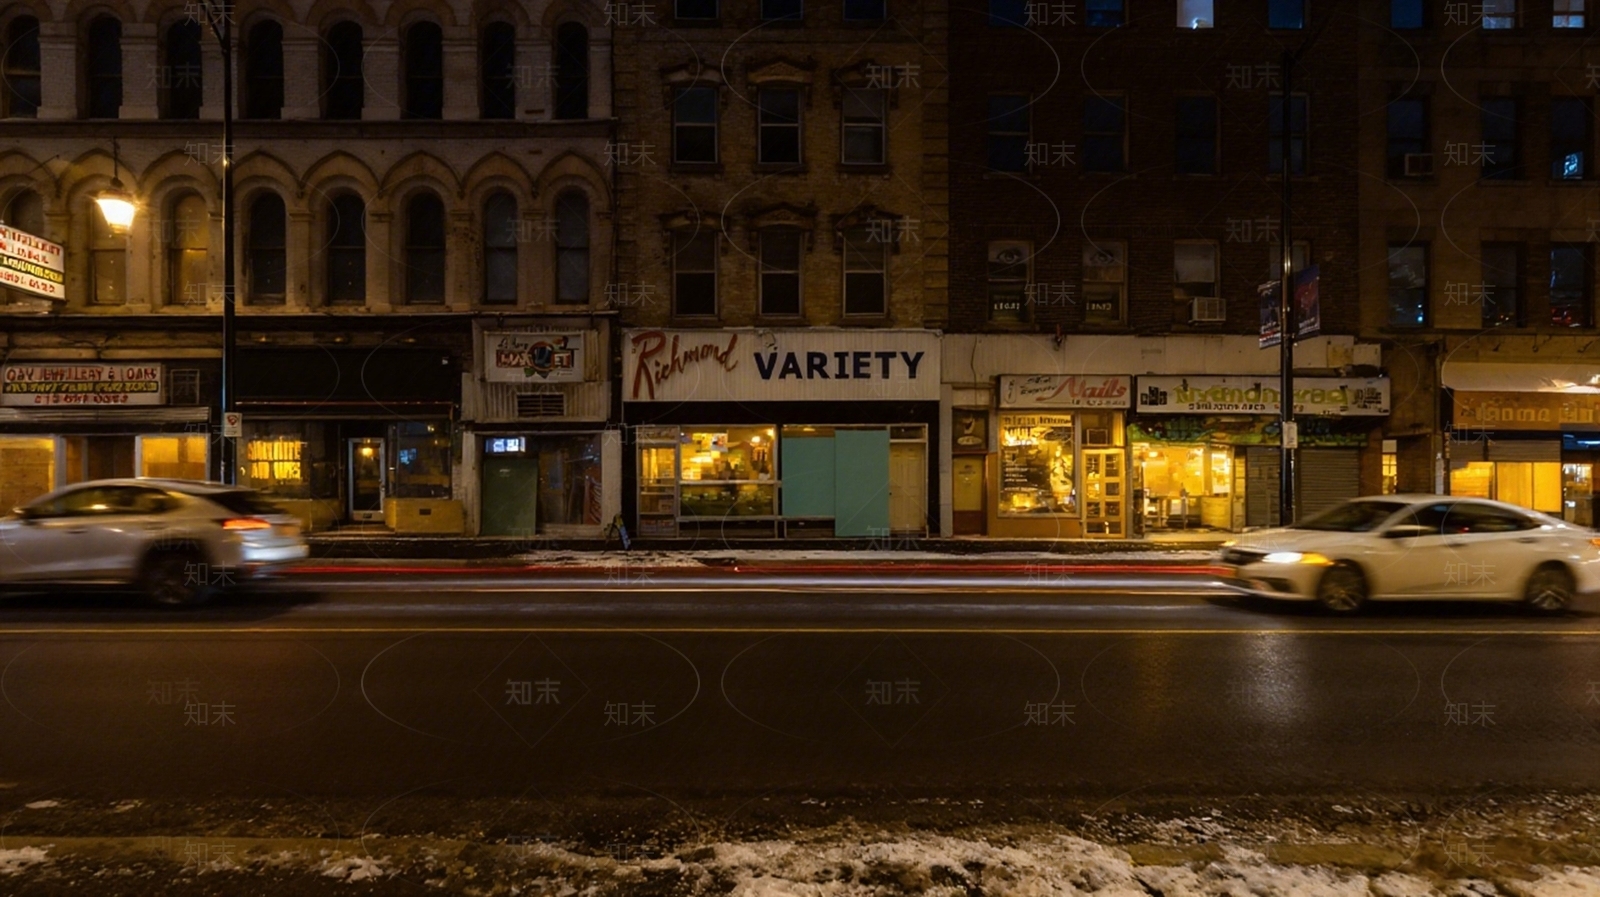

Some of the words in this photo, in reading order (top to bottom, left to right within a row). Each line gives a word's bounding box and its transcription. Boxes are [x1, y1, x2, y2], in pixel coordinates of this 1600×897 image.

[631, 331, 738, 400] Richmond
[754, 350, 924, 380] VARIETY
[1036, 376, 1127, 401] Nails
